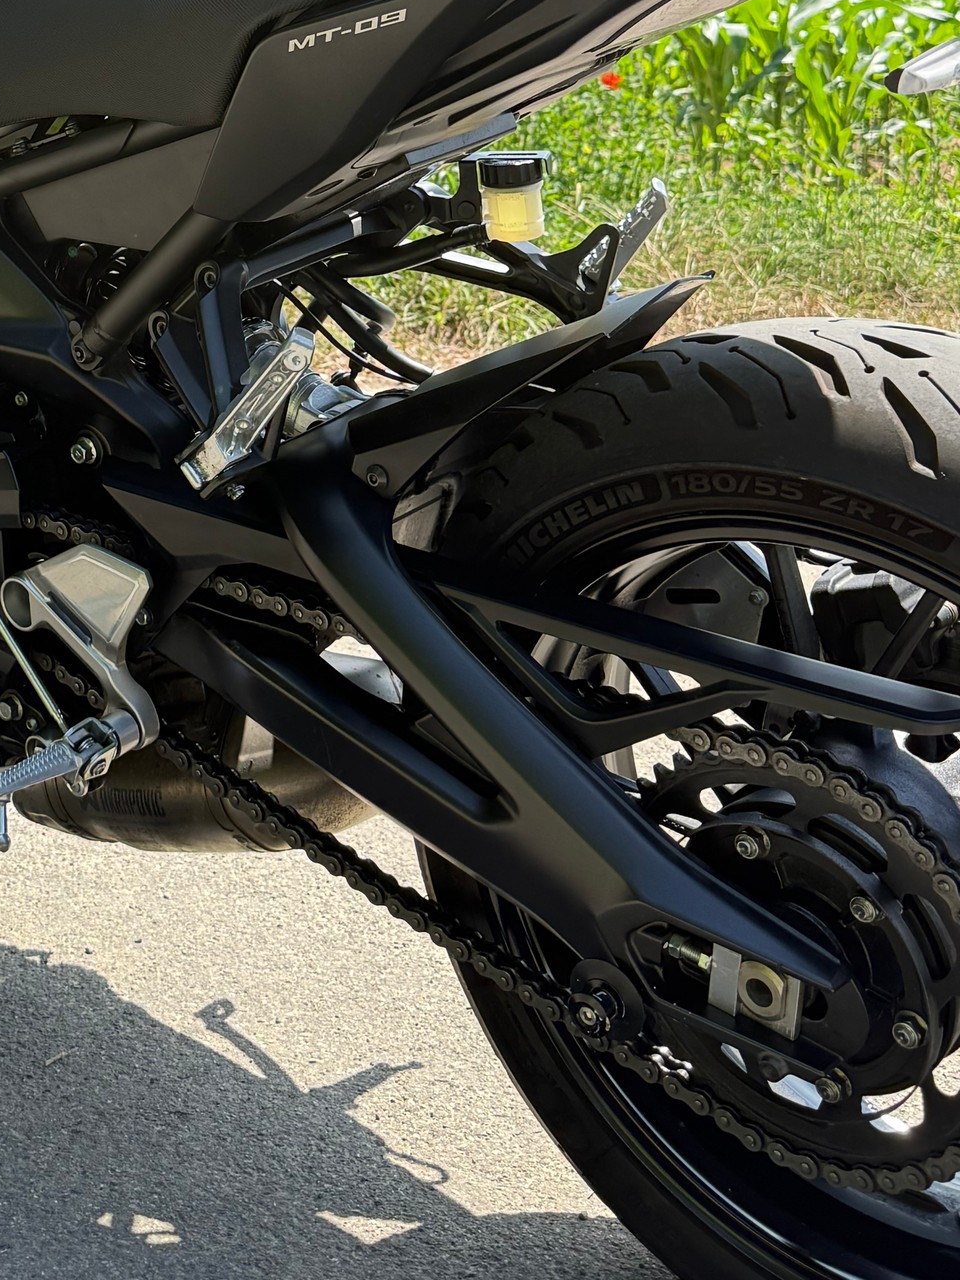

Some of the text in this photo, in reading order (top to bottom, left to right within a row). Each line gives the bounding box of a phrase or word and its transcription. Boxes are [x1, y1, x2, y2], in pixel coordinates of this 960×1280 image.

[288, 8, 407, 52] MT-09
[671, 473, 803, 501] 180/55
[819, 490, 874, 521] ZR
[888, 514, 934, 538] 17
